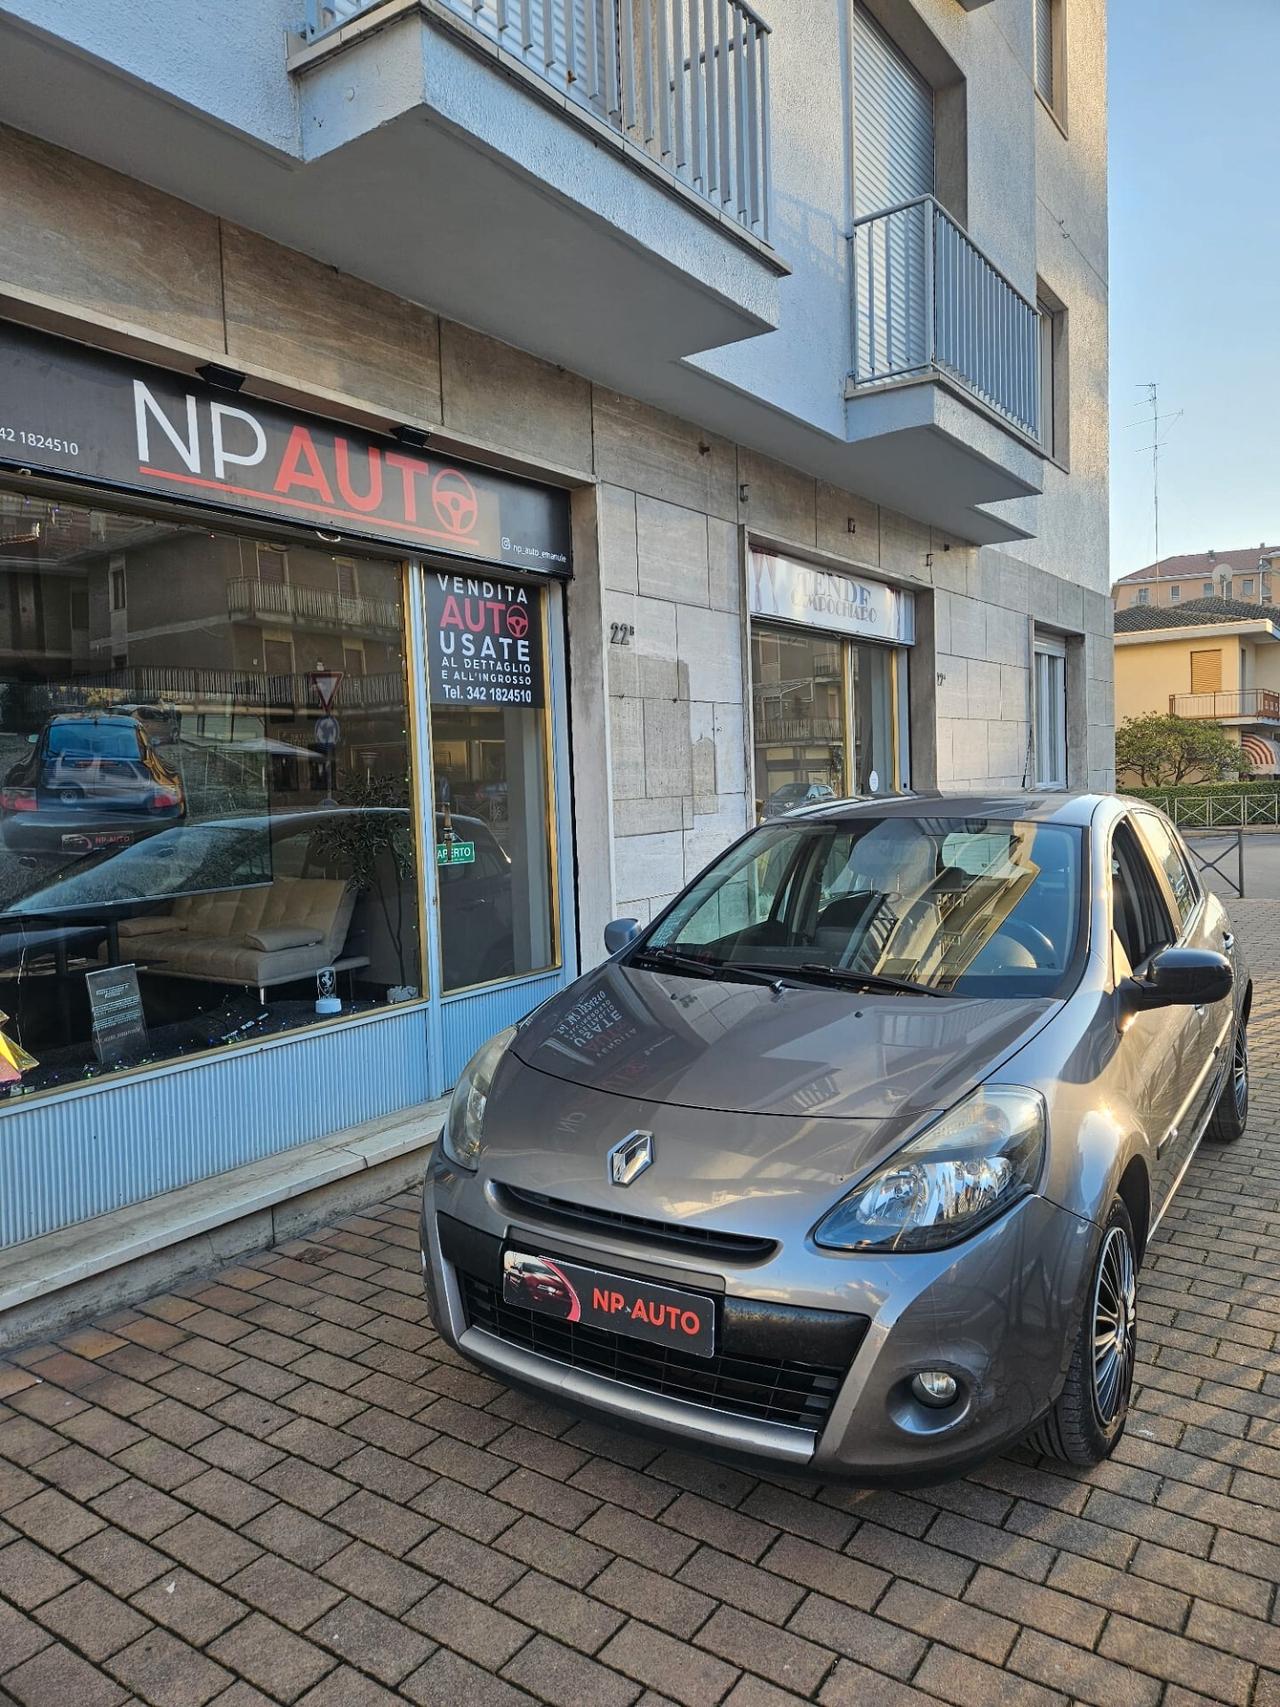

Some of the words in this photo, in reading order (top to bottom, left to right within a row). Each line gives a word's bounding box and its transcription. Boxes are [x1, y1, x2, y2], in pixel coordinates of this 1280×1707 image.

[20, 431, 79, 456] 1824510
[436, 573, 528, 604] VENDITA
[439, 595, 529, 638] AUTO
[439, 630, 530, 662] USATE
[441, 656, 458, 668] AL
[464, 658, 531, 674] DETTAGLIO
[441, 669, 448, 680] E
[453, 671, 532, 686] ALL'INGROSSO
[442, 684, 464, 699] Tel.
[466, 685, 487, 701] 342
[489, 687, 532, 703] 1824510
[437, 847, 471, 858] APRTO
